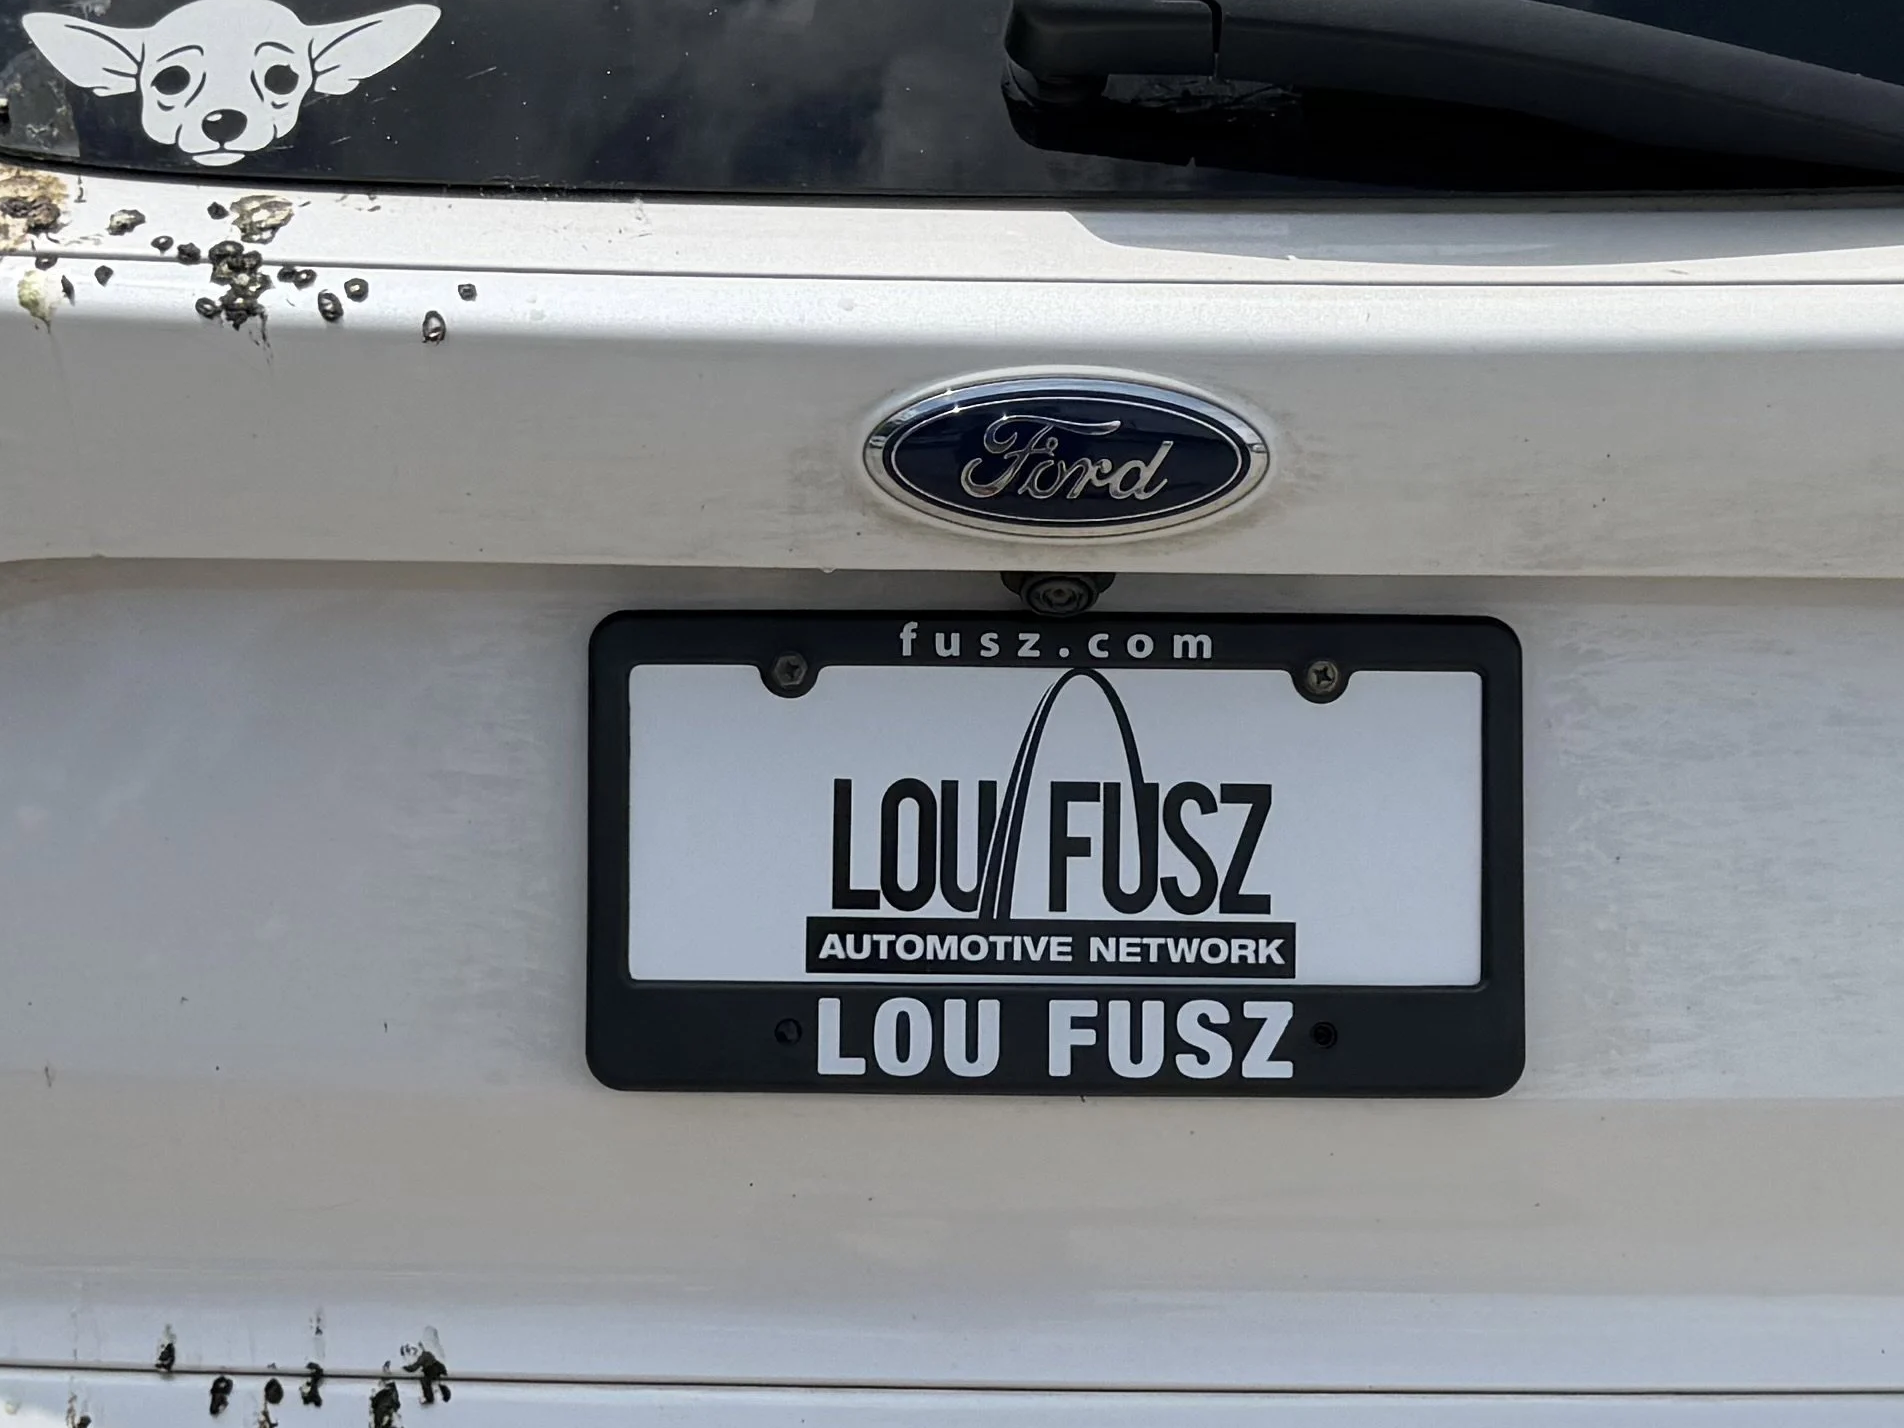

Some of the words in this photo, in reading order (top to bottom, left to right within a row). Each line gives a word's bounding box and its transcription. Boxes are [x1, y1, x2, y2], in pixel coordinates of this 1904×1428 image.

[960, 414, 1174, 501] Ford
[899, 621, 1214, 660] fusz.com
[831, 778, 998, 913] LOU
[1048, 781, 1273, 916] FUSZ
[817, 932, 1074, 964] AUTOMOTIVE
[1088, 936, 1287, 967] NETWORK
[816, 996, 1001, 1078] LOU
[1048, 999, 1295, 1081] FUSZ
